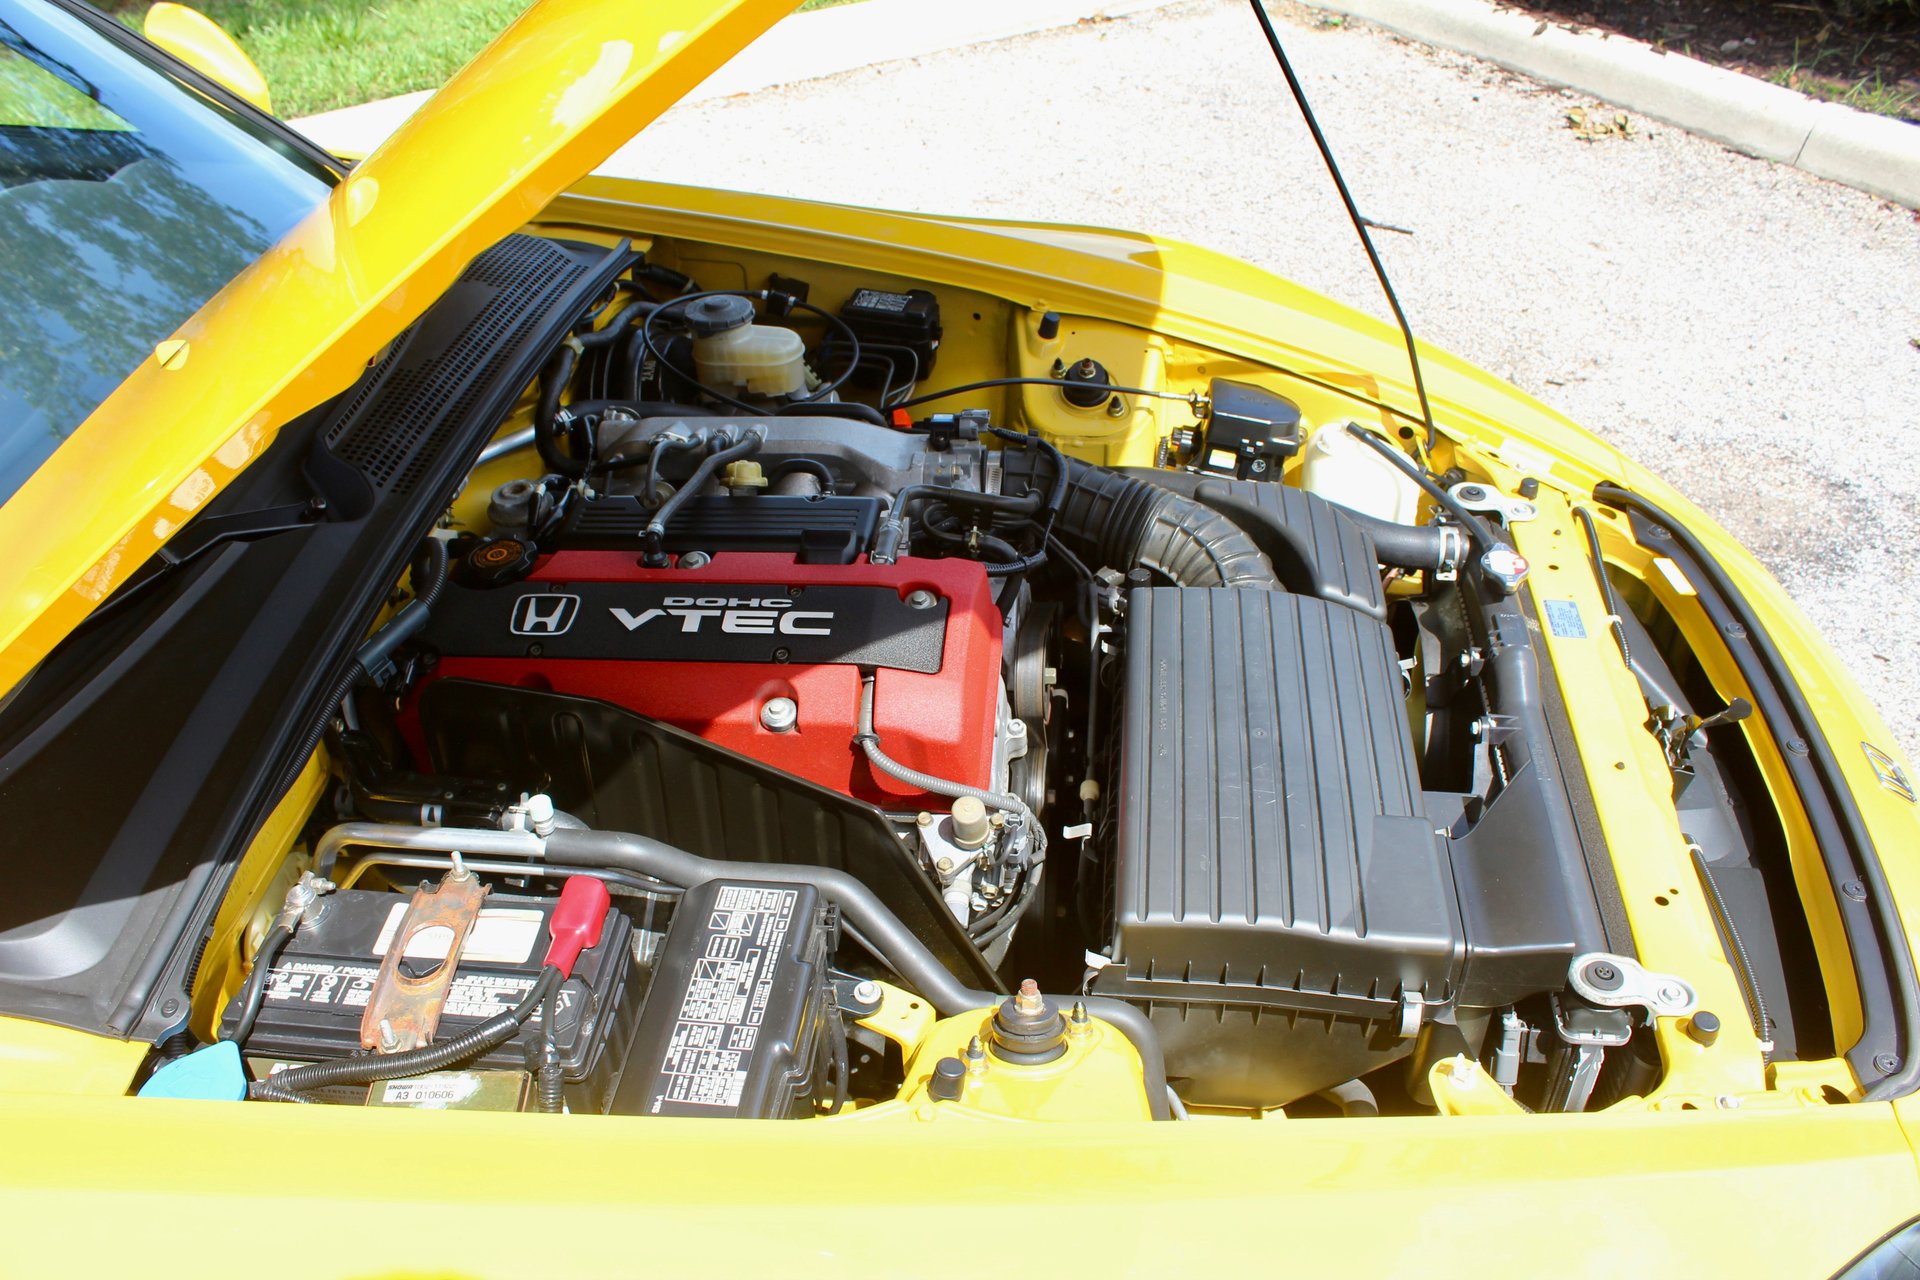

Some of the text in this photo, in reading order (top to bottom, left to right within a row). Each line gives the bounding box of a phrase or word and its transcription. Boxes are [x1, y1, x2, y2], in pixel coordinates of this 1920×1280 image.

[663, 597, 794, 609] DOHC
[609, 607, 834, 635] VTEC
[293, 962, 335, 974] DANGER
[395, 1090, 454, 1100] A3 010606
